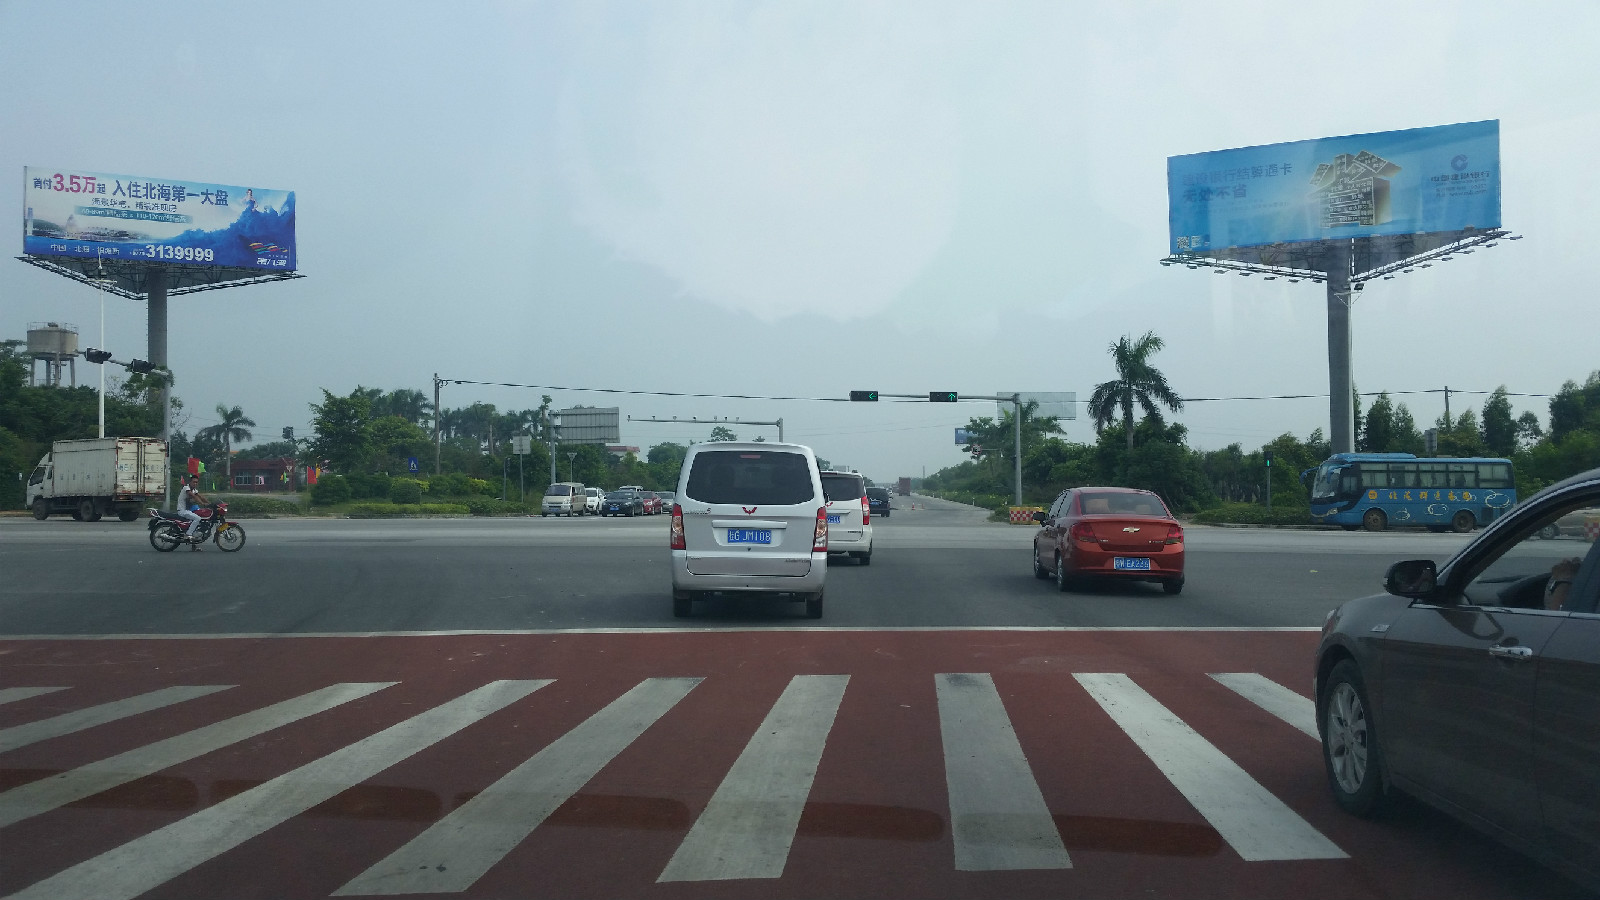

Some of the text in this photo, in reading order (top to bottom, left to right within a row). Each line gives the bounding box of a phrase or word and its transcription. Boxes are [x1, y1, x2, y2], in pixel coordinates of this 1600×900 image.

[112, 180, 229, 206] 入住北海第一大盘
